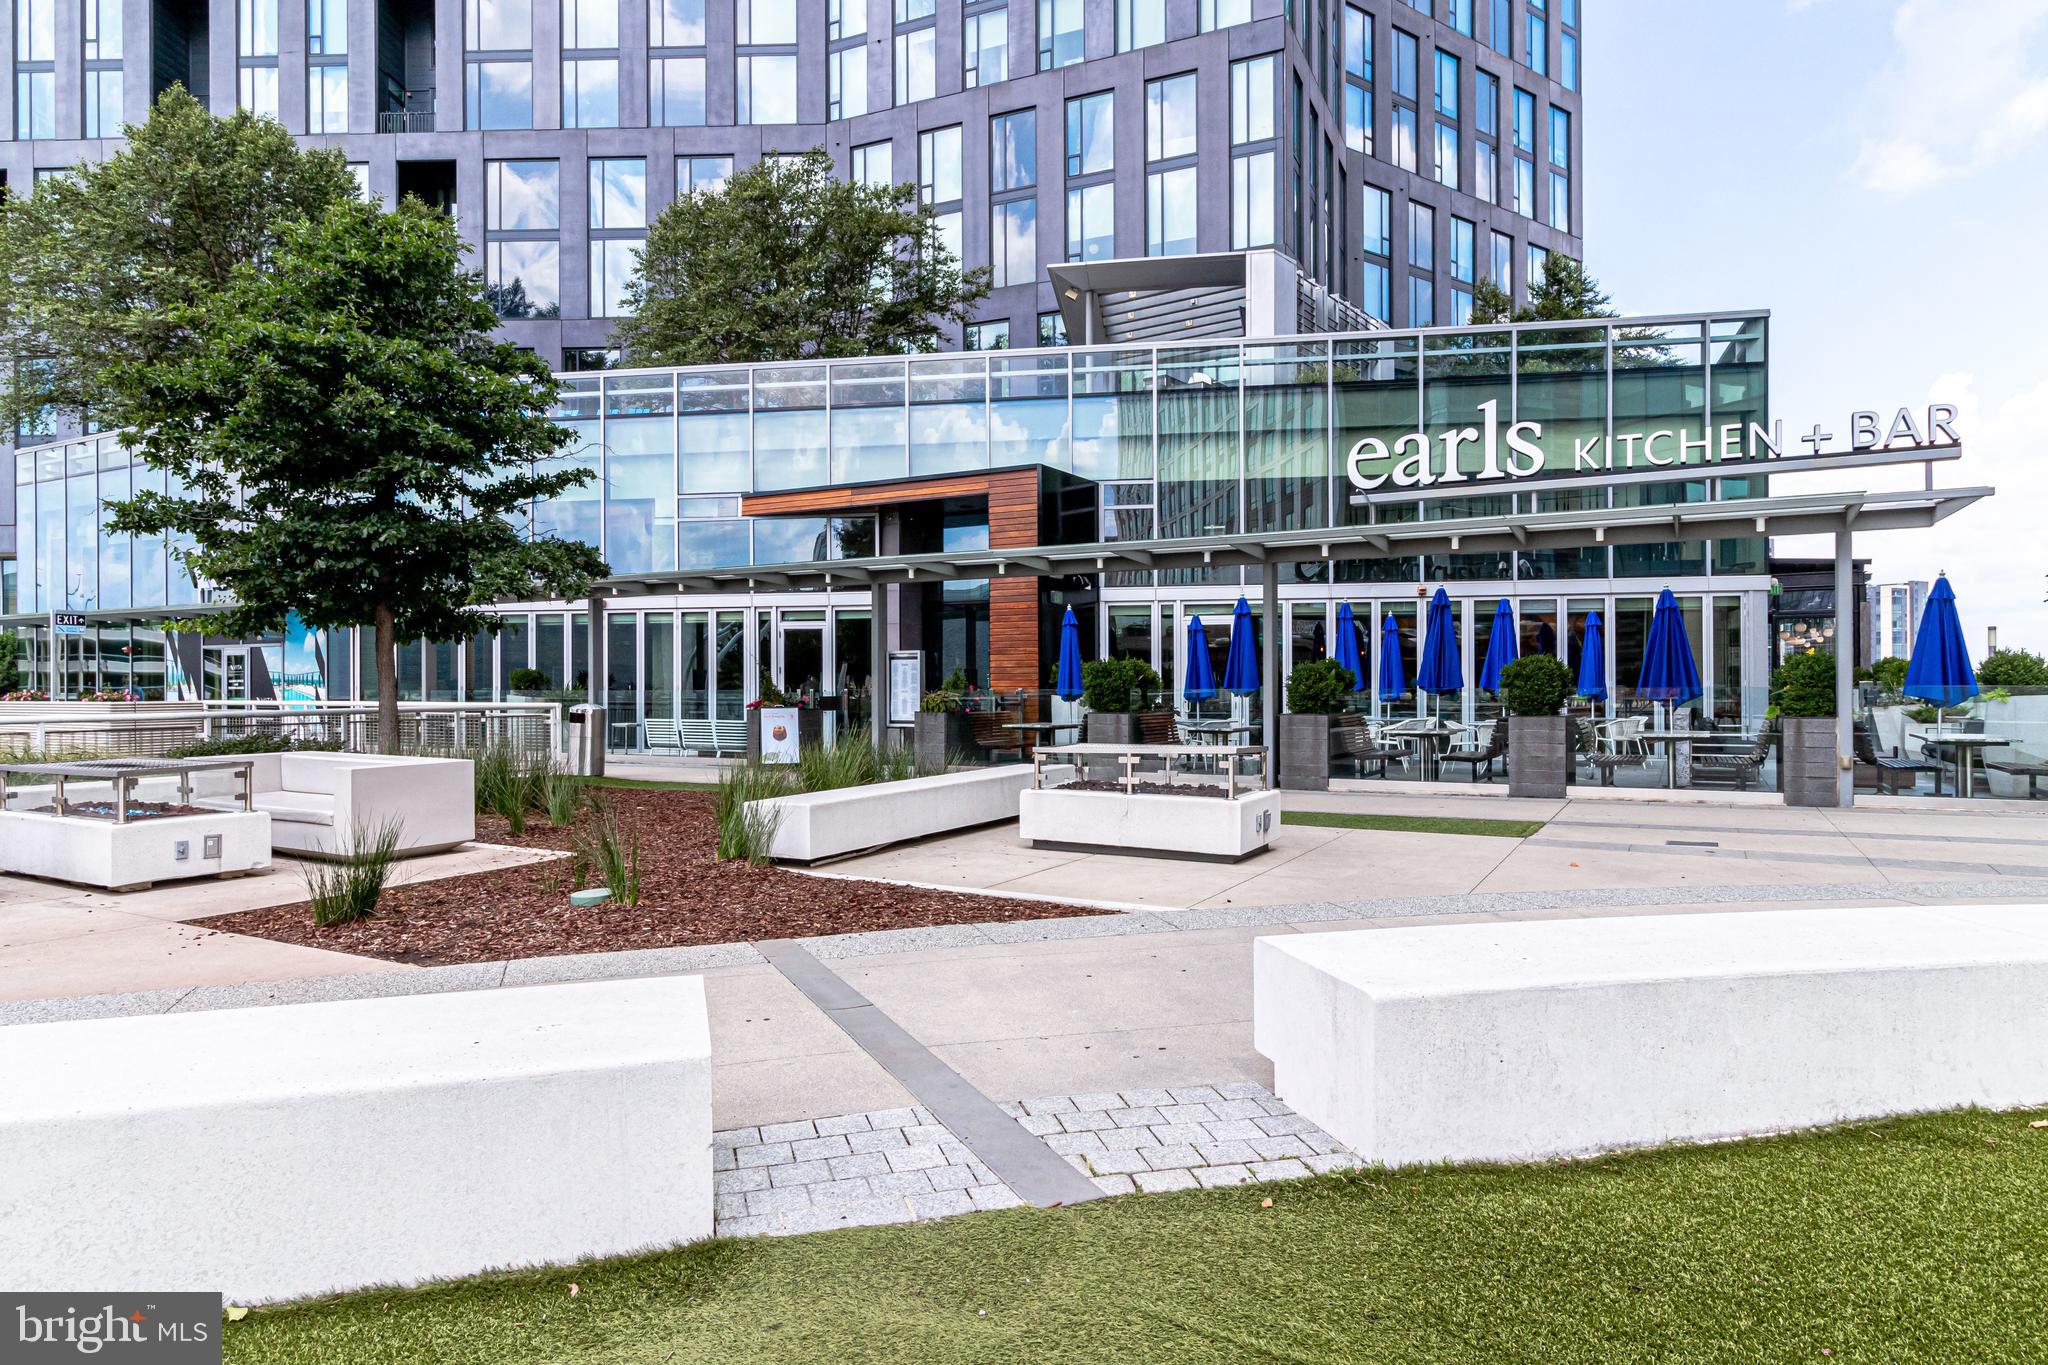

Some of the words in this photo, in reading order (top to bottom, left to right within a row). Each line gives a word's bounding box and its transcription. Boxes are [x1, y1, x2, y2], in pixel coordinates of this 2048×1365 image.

[1347, 399, 1545, 490] earls
[1574, 419, 1783, 474] KITCHEN
[1851, 403, 1961, 452] BAR
[56, 614, 79, 625] EXIT
